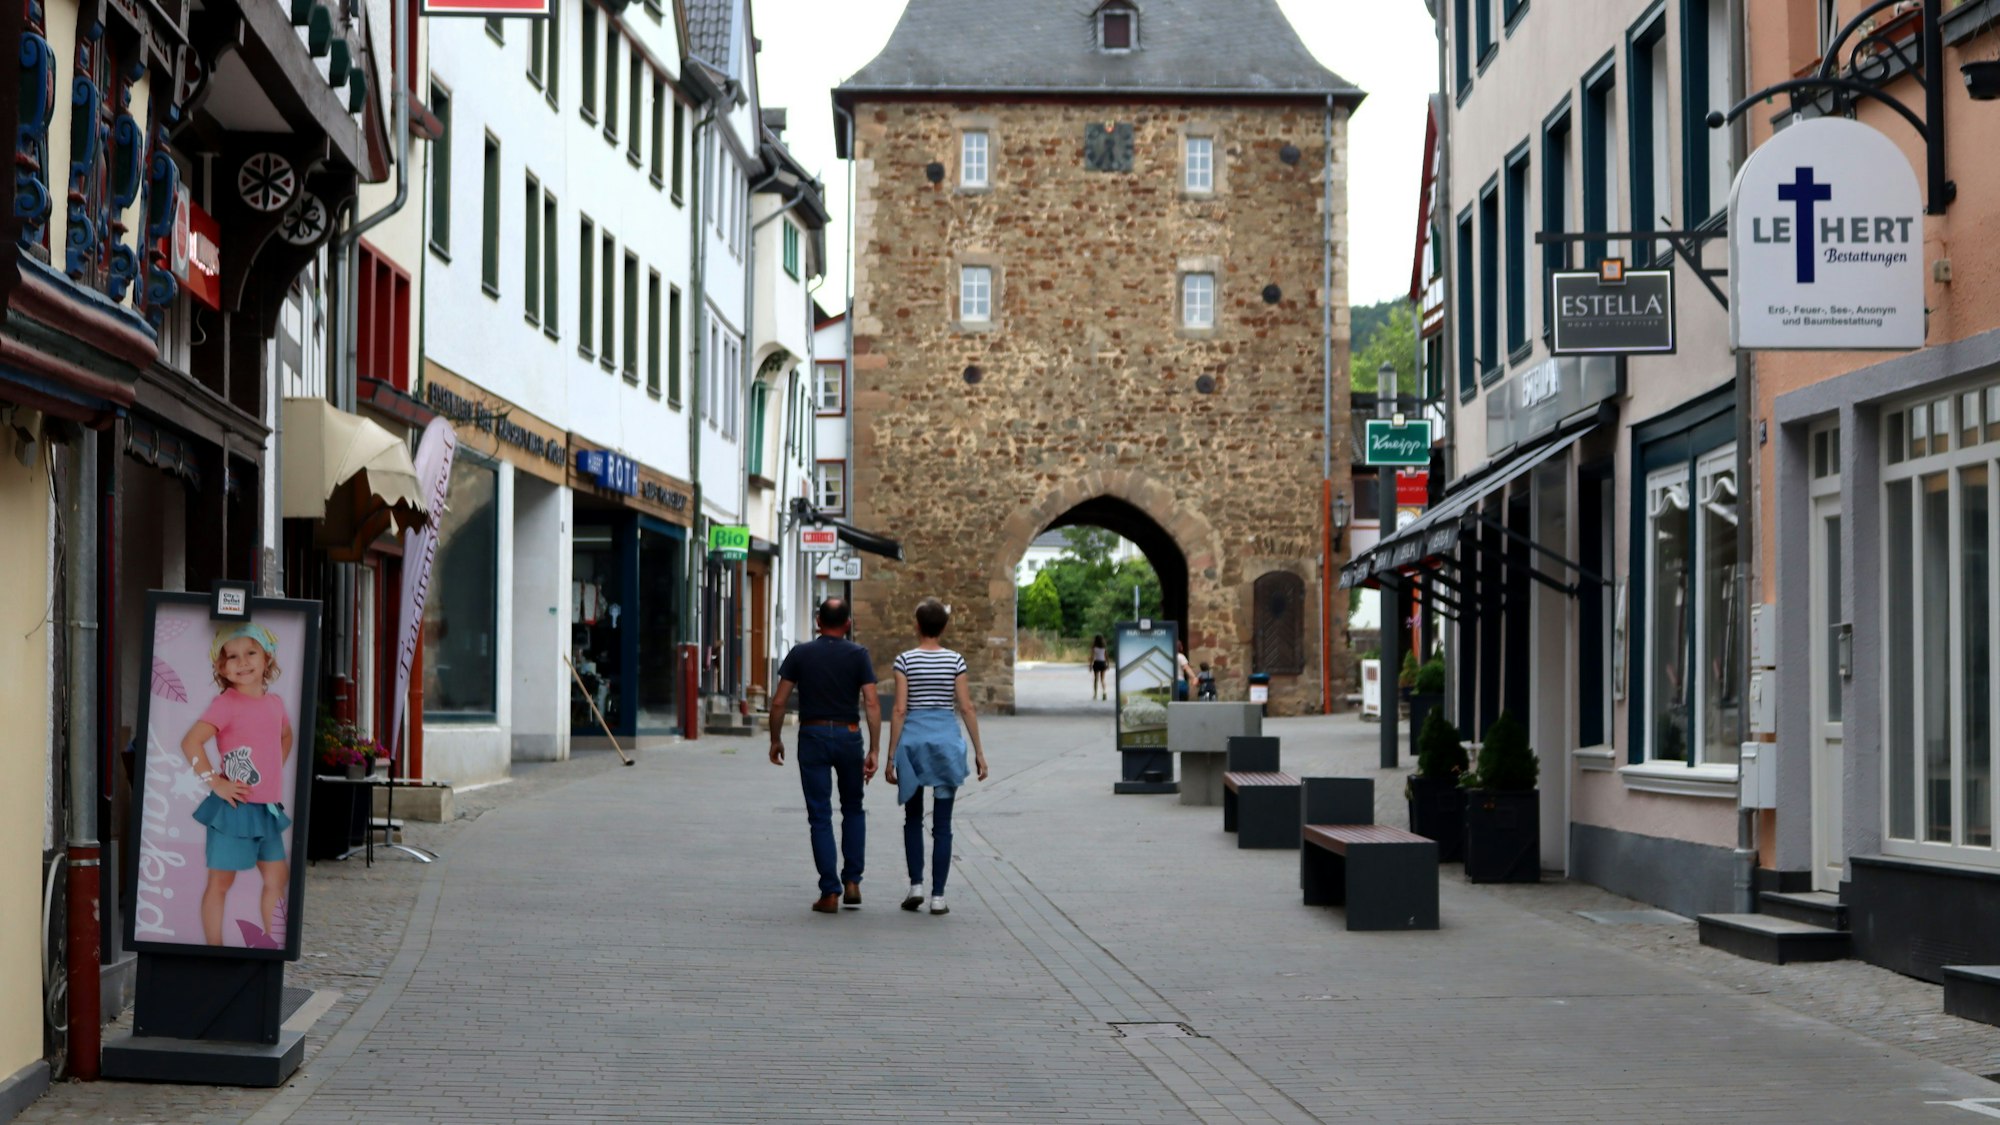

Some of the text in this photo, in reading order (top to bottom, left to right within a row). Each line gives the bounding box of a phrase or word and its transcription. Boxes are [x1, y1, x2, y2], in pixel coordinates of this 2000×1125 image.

[1824, 248, 1908, 267] Bestattungen
[1562, 294, 1663, 317] ESTELLA
[1768, 305, 1897, 316] Erd-, Feuer-, See-, Anonym
[1782, 317, 1883, 328] und Baumbestattung
[1371, 434, 1421, 456] Kneipp
[608, 454, 638, 496] ROTH
[715, 530, 744, 546] Bio
